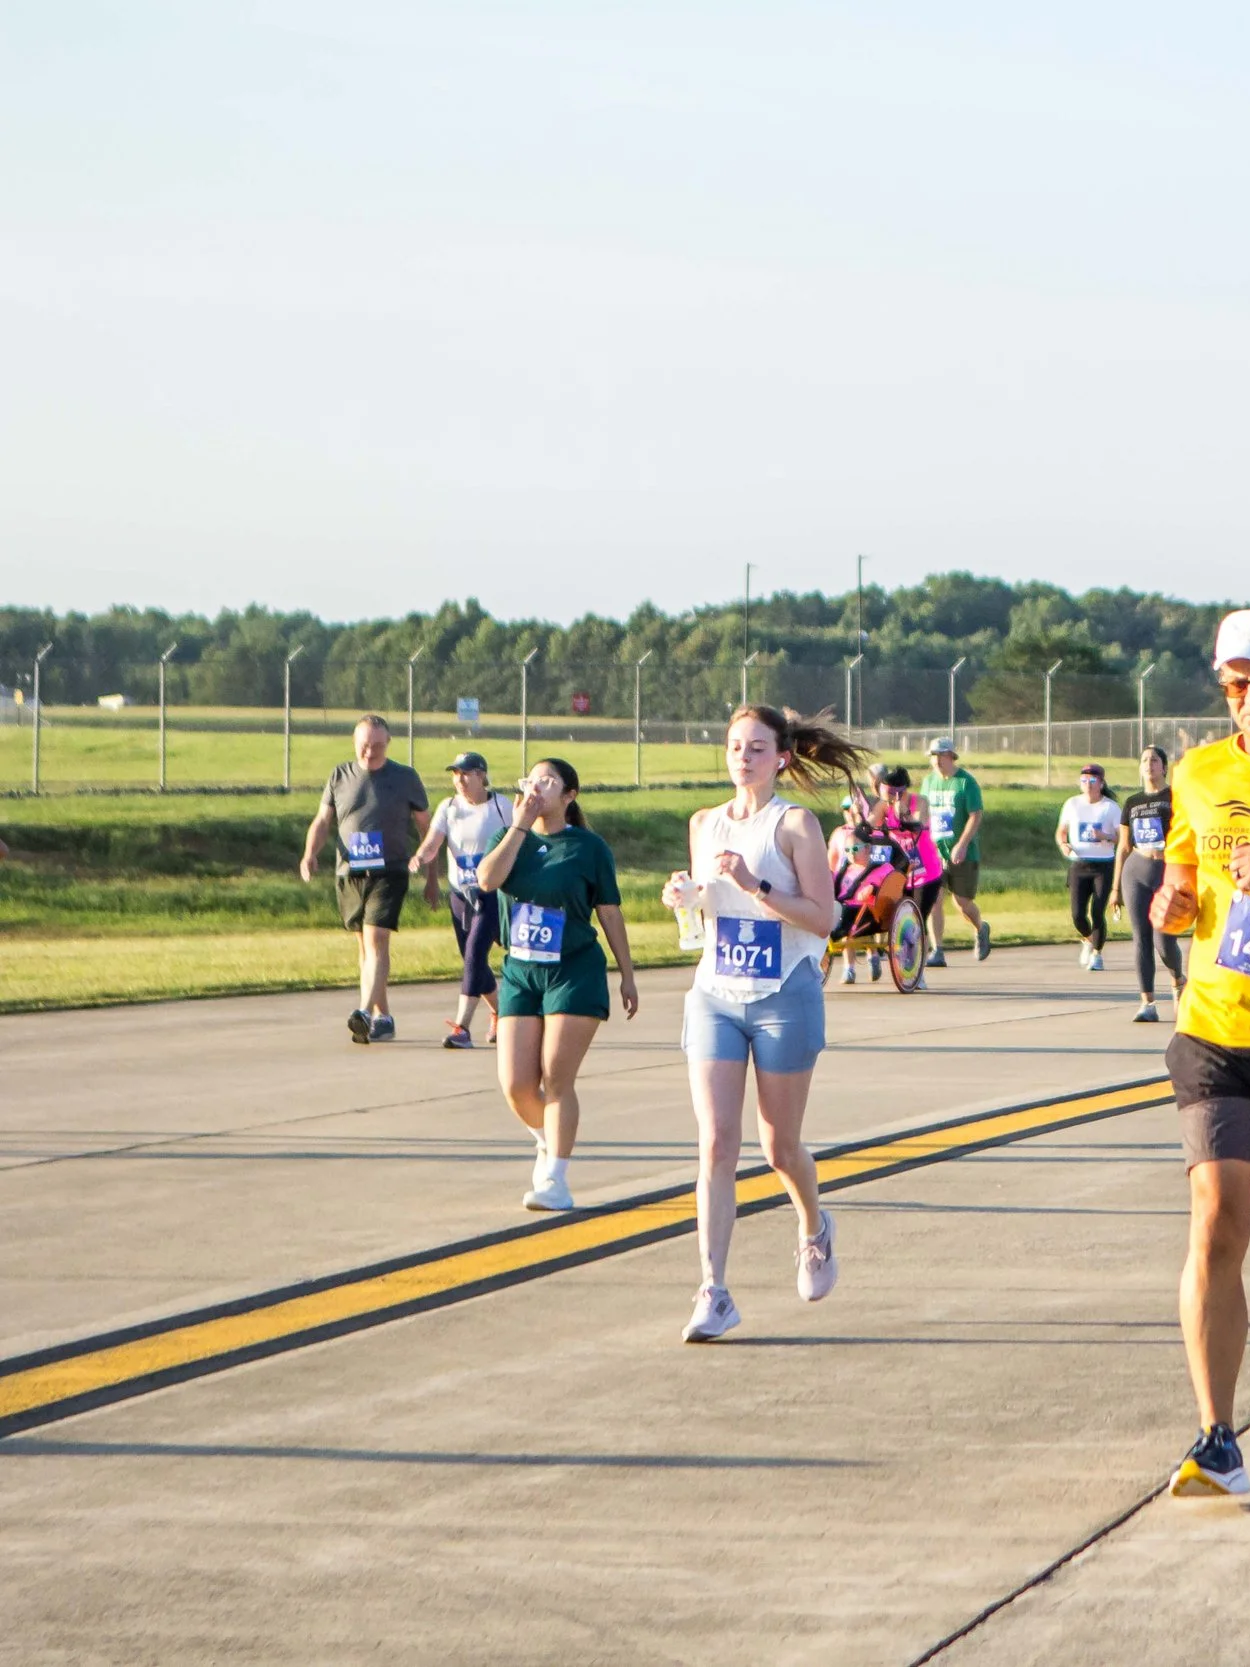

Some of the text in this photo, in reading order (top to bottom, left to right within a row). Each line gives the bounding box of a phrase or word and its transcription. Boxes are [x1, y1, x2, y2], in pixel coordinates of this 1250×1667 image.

[1138, 829, 1158, 839] 725
[351, 844, 380, 856] 1404
[517, 923, 552, 943] 579
[721, 944, 773, 968] 1071
